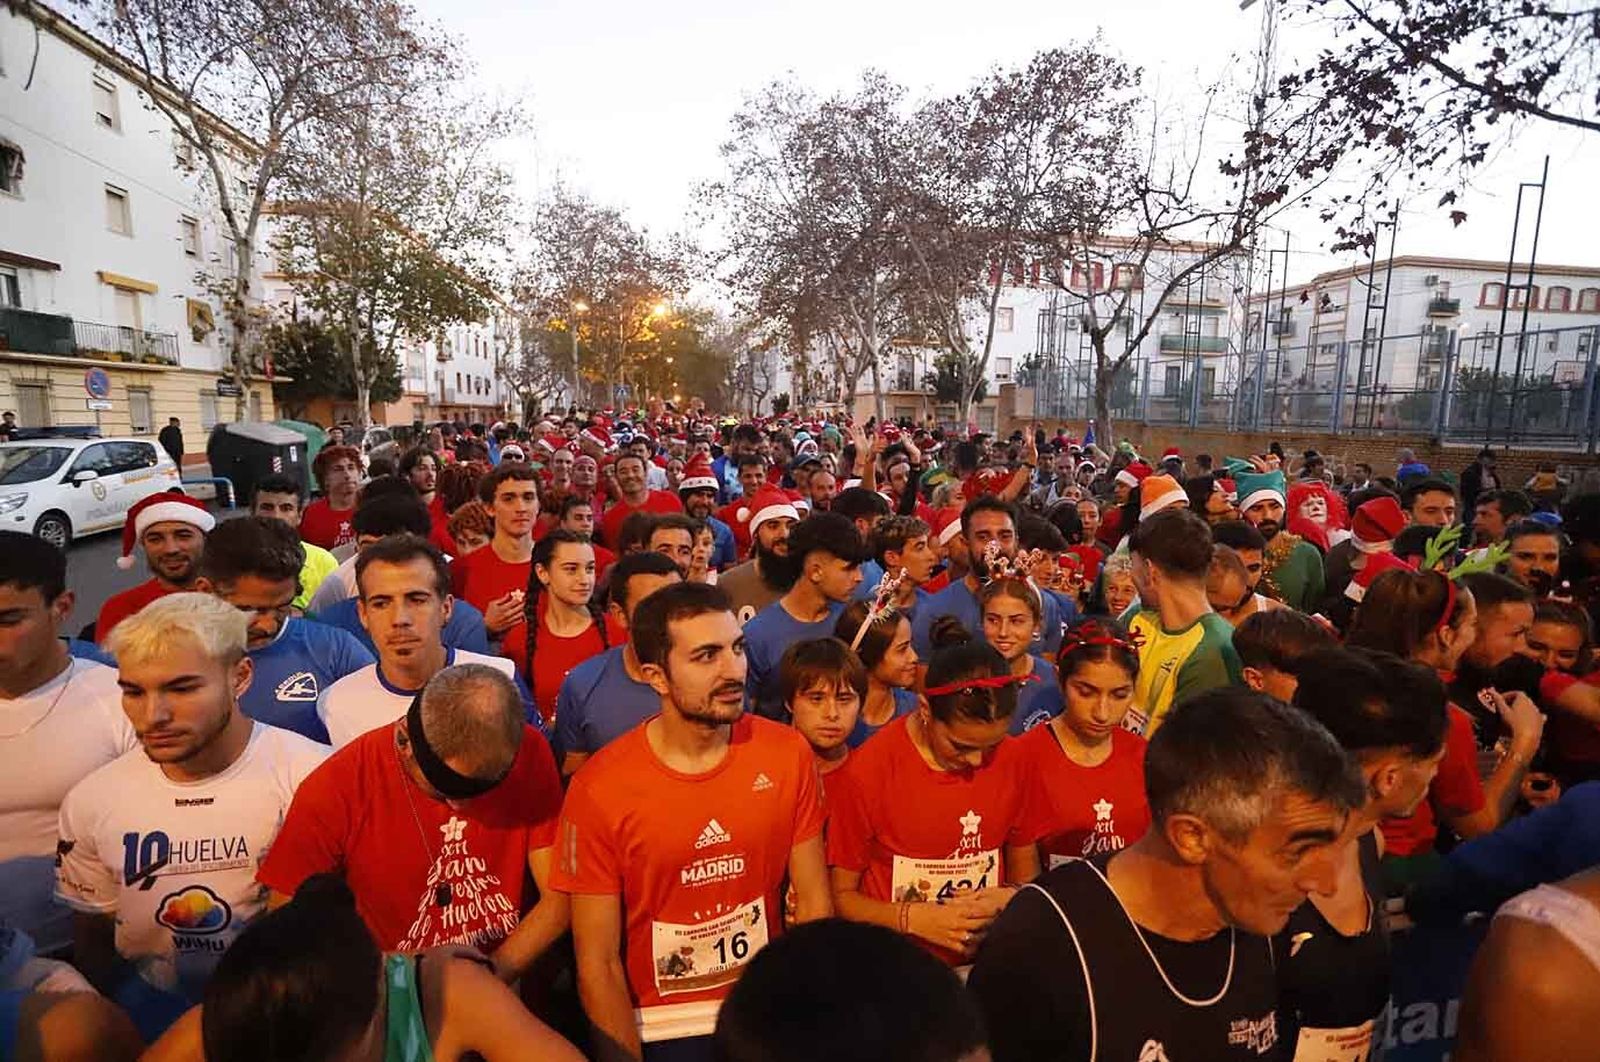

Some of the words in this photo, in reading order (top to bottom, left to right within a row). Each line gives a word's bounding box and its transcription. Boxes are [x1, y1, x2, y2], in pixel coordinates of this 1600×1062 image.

[169, 836, 249, 864] HUELVA
[694, 833, 731, 849] adidas
[681, 858, 744, 884] MADRID
[440, 891, 515, 929] Huelva
[712, 931, 749, 965] 16
